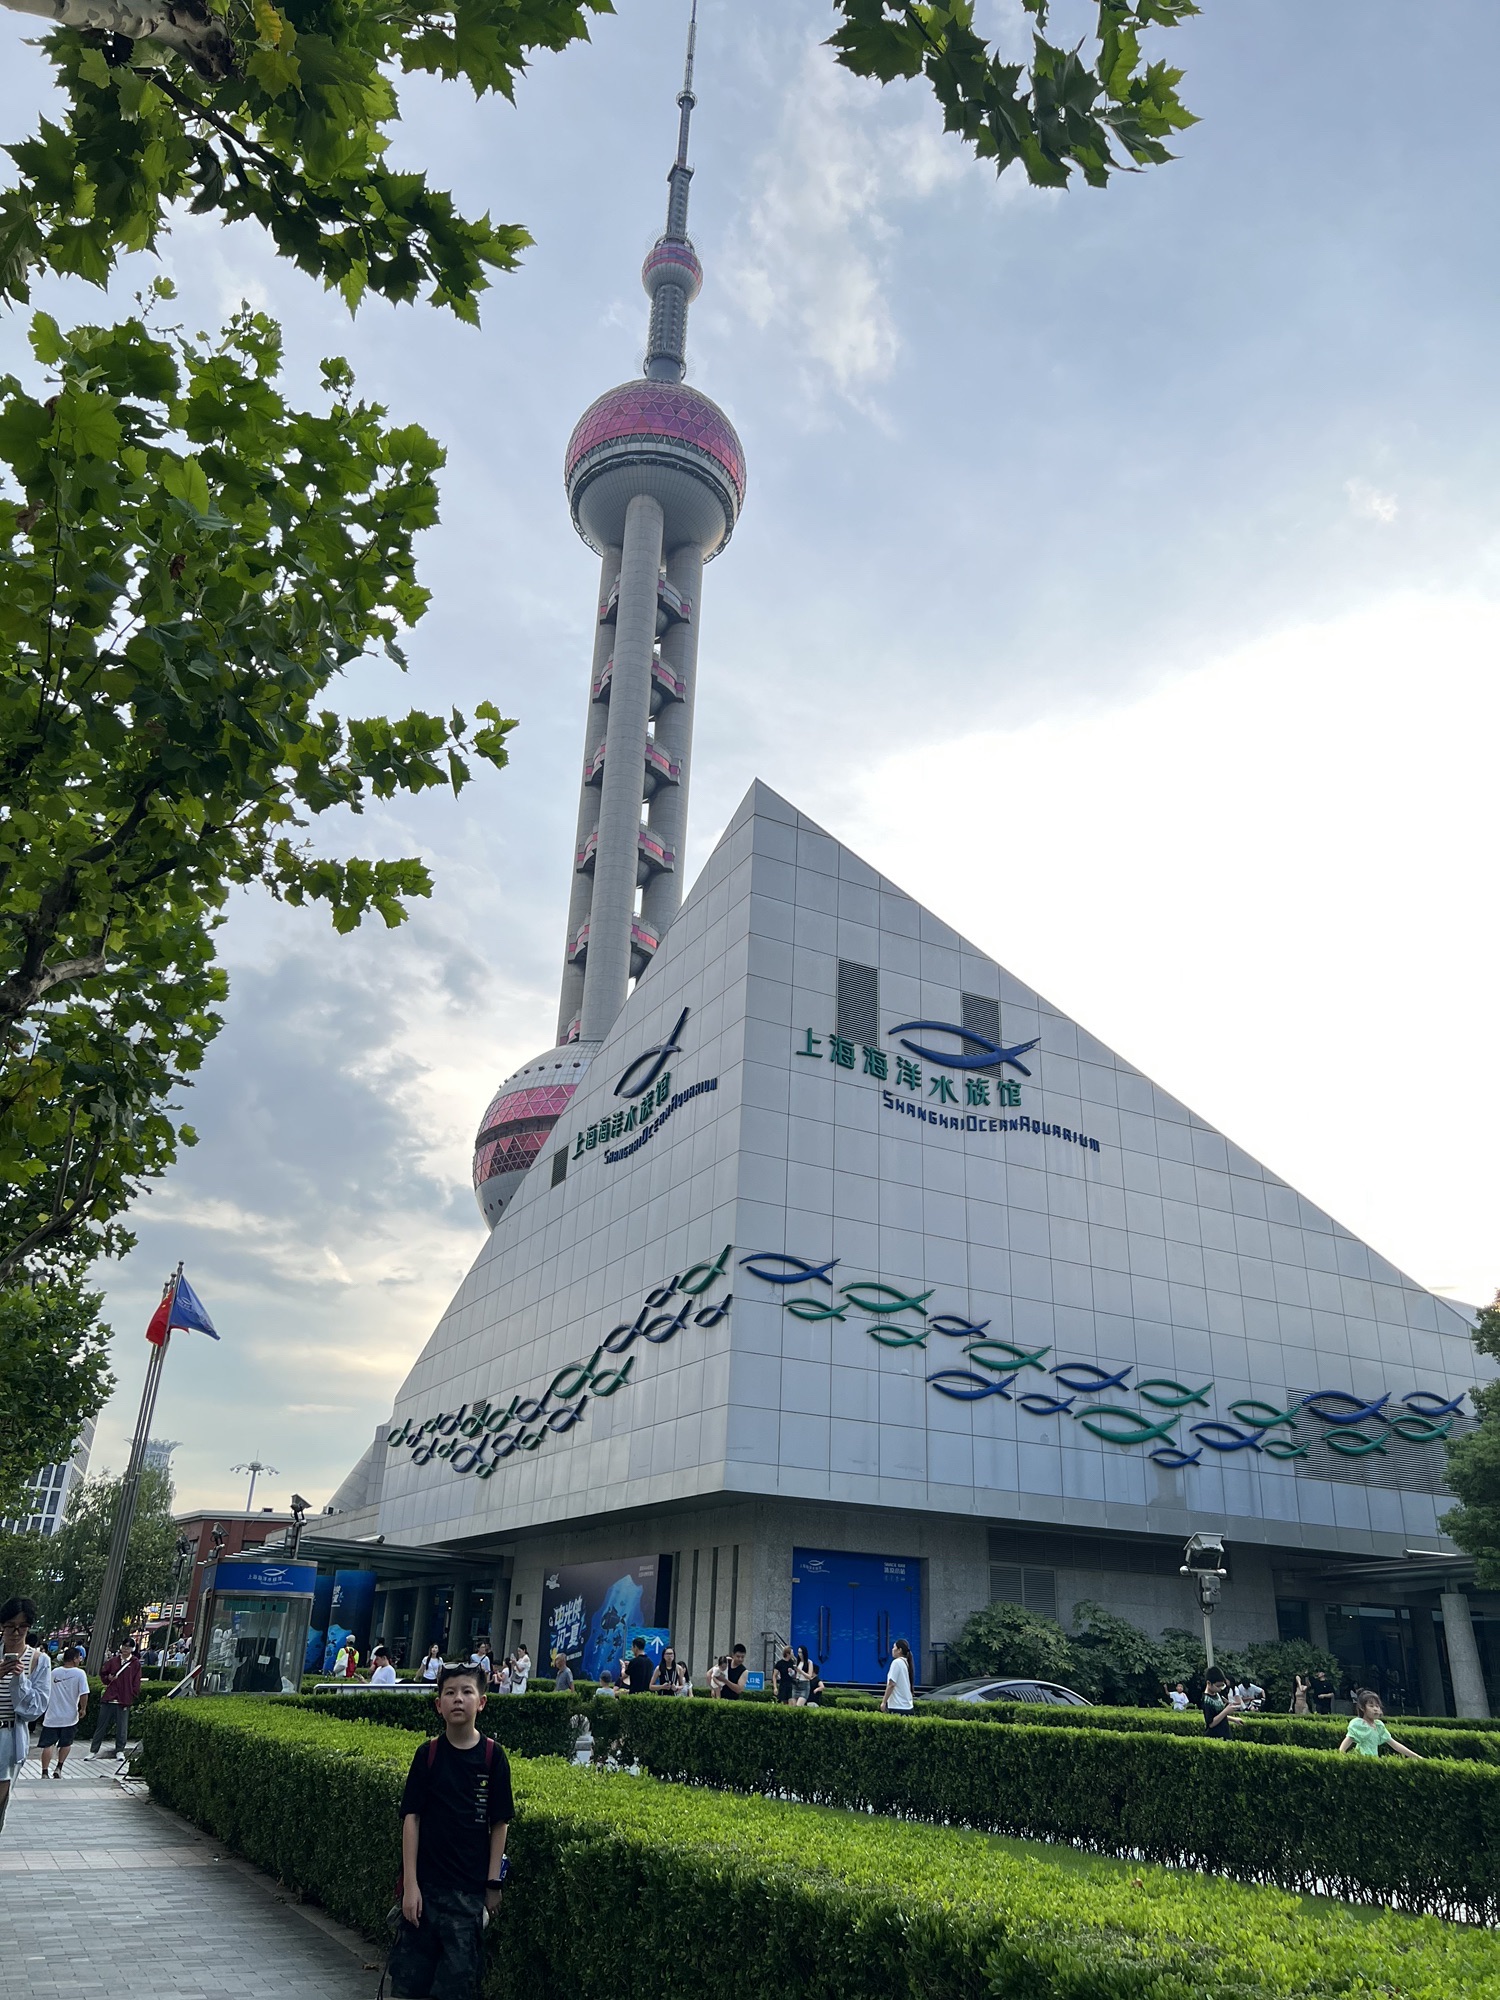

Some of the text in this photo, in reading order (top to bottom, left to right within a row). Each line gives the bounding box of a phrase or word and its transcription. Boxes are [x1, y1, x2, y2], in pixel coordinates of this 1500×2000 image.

[796, 1027, 1022, 1107] 上海海洋水族馆
[571, 1071, 671, 1160] 上海海洋水族馆
[556, 1622, 580, 1649] 闪一夏
